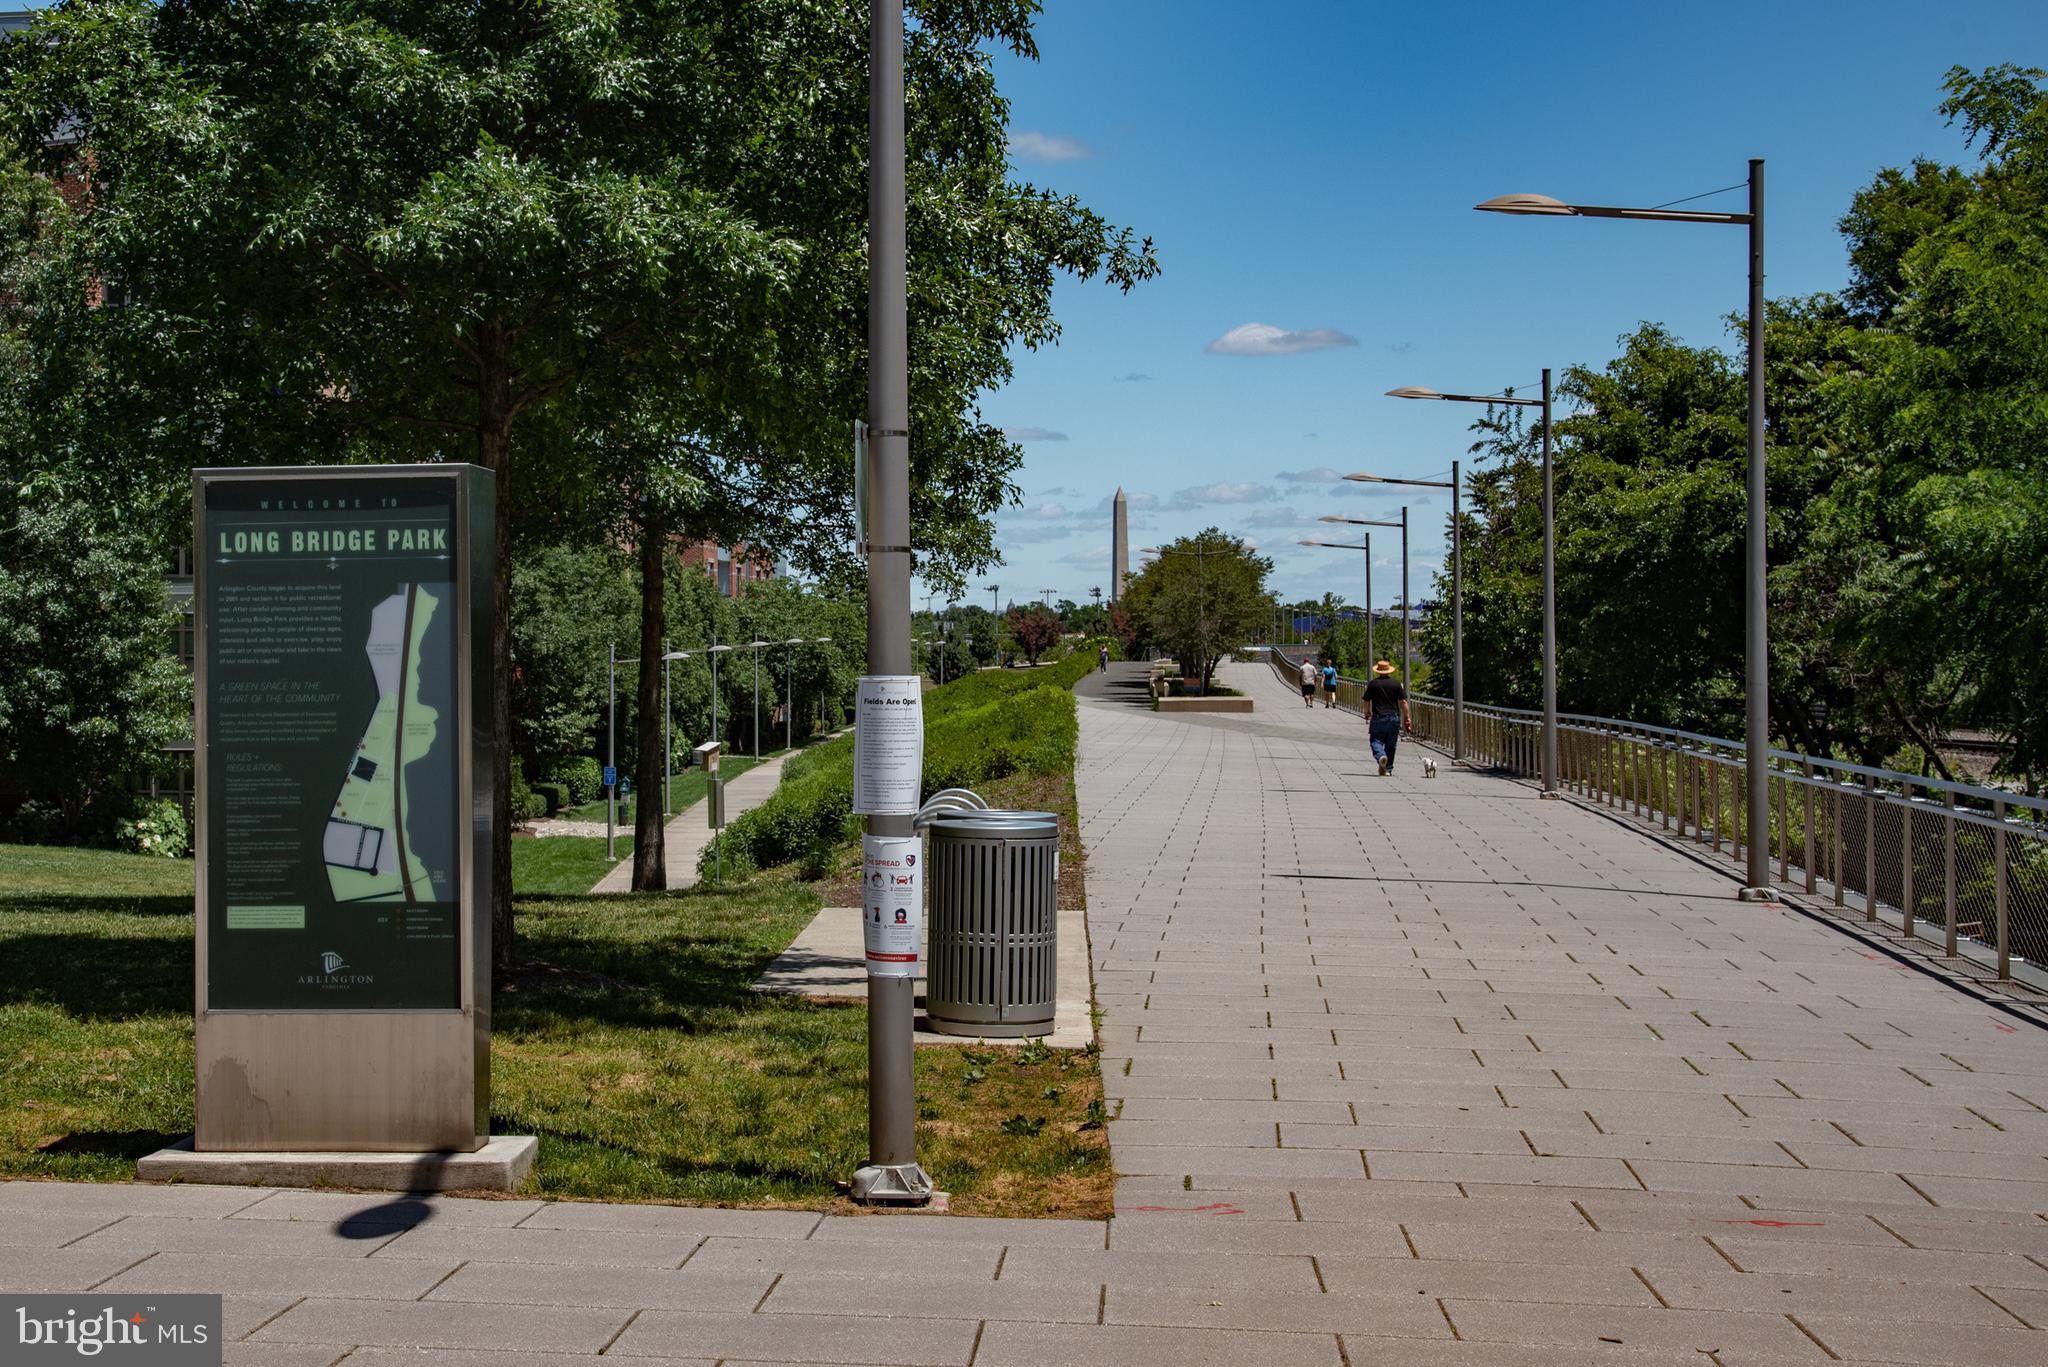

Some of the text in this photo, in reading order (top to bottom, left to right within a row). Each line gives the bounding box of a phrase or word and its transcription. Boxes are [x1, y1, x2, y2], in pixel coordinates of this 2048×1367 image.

[260, 498, 397, 509] WELCOME TO
[220, 528, 447, 553] LONG BRIDGE PARK
[227, 681, 258, 691] GREEN
[260, 680, 288, 690] SPACE
[290, 680, 301, 690] IN
[304, 680, 321, 690] THE
[219, 693, 341, 704] HEART OF THE COMMUNITY
[902, 698, 917, 706] Open
[874, 859, 900, 867] SPREAD
[298, 975, 374, 984] ARLINGTON
